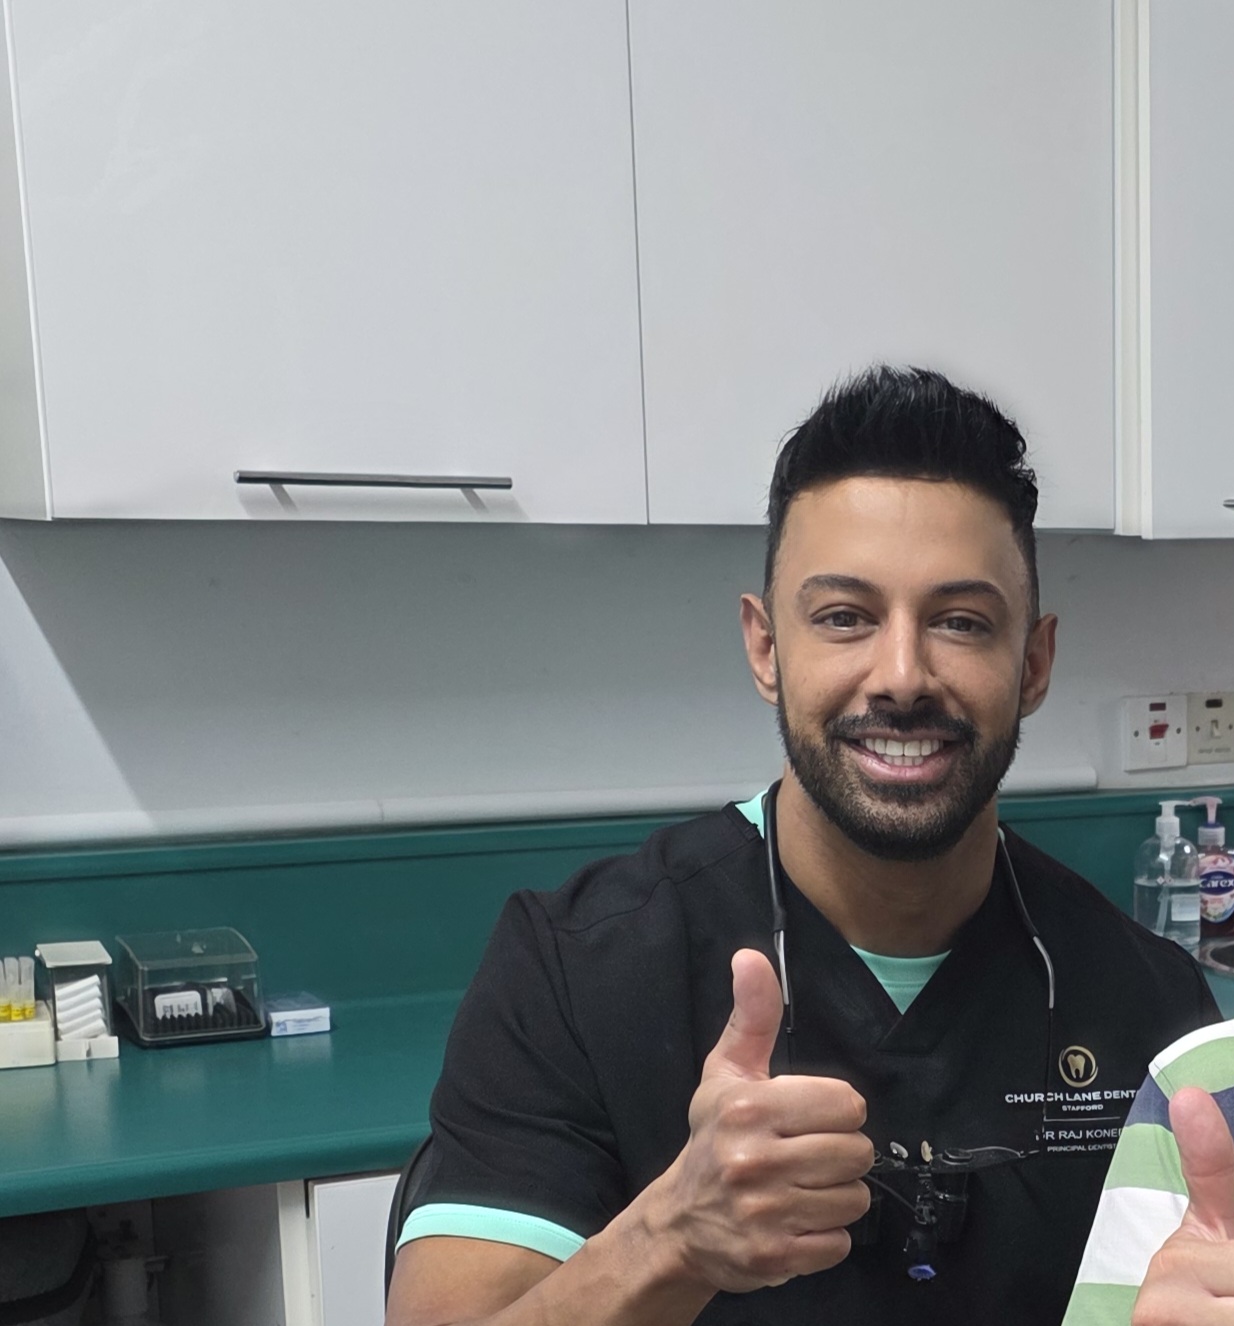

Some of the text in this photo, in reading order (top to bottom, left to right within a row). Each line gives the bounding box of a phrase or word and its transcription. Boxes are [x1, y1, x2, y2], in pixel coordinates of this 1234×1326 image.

[1199, 878, 1234, 888] Carex
[1005, 1089, 1138, 1103] CHURCH LANE DENT
[1058, 1130, 1083, 1140] RAJ
